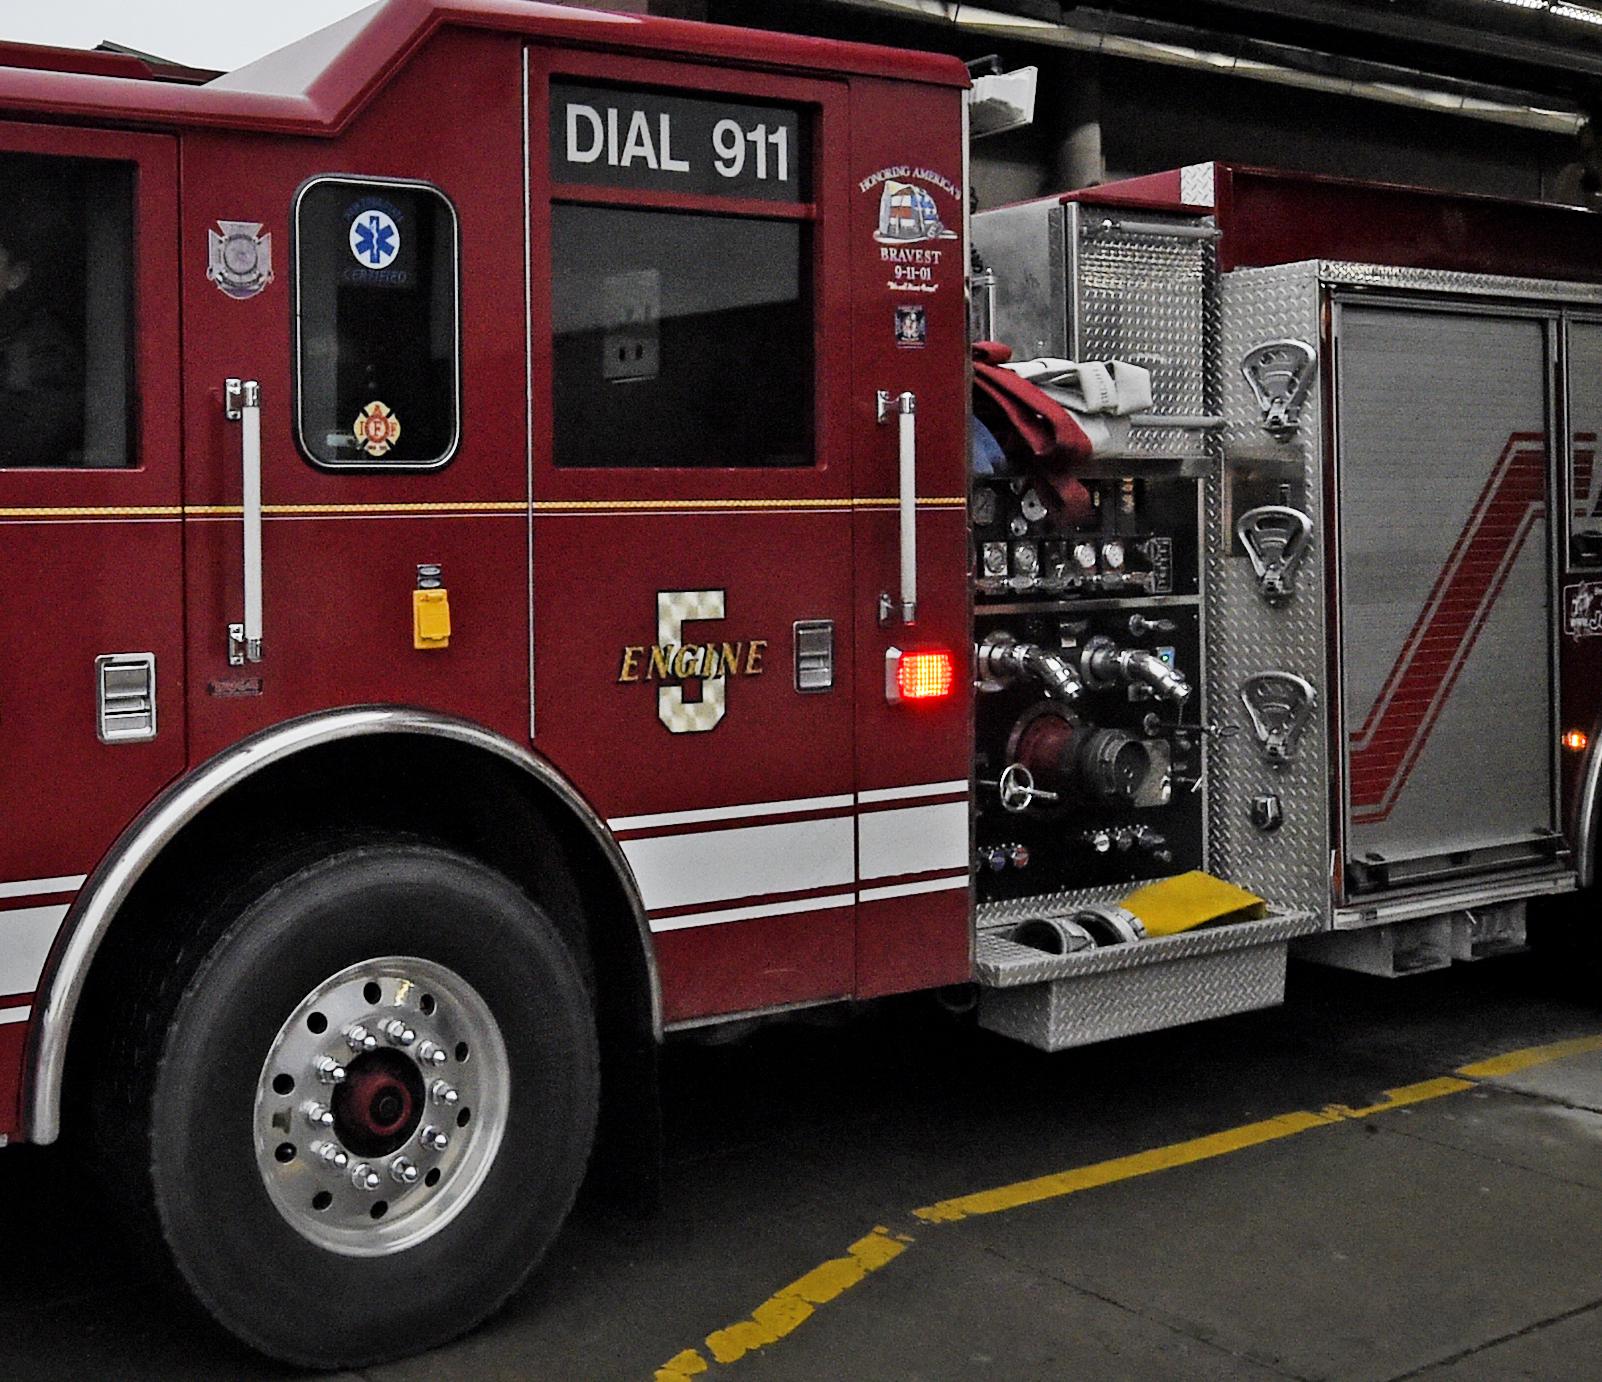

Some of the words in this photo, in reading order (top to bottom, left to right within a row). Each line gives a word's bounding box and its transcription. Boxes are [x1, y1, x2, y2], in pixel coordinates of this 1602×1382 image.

[566, 103, 690, 173] DIAL
[712, 118, 788, 181] 911
[858, 166, 911, 193] HONORING
[880, 247, 941, 265] BRAVEST
[894, 266, 931, 280] 9-11-01
[618, 640, 768, 682] ENGINE
[657, 590, 726, 733] 5
